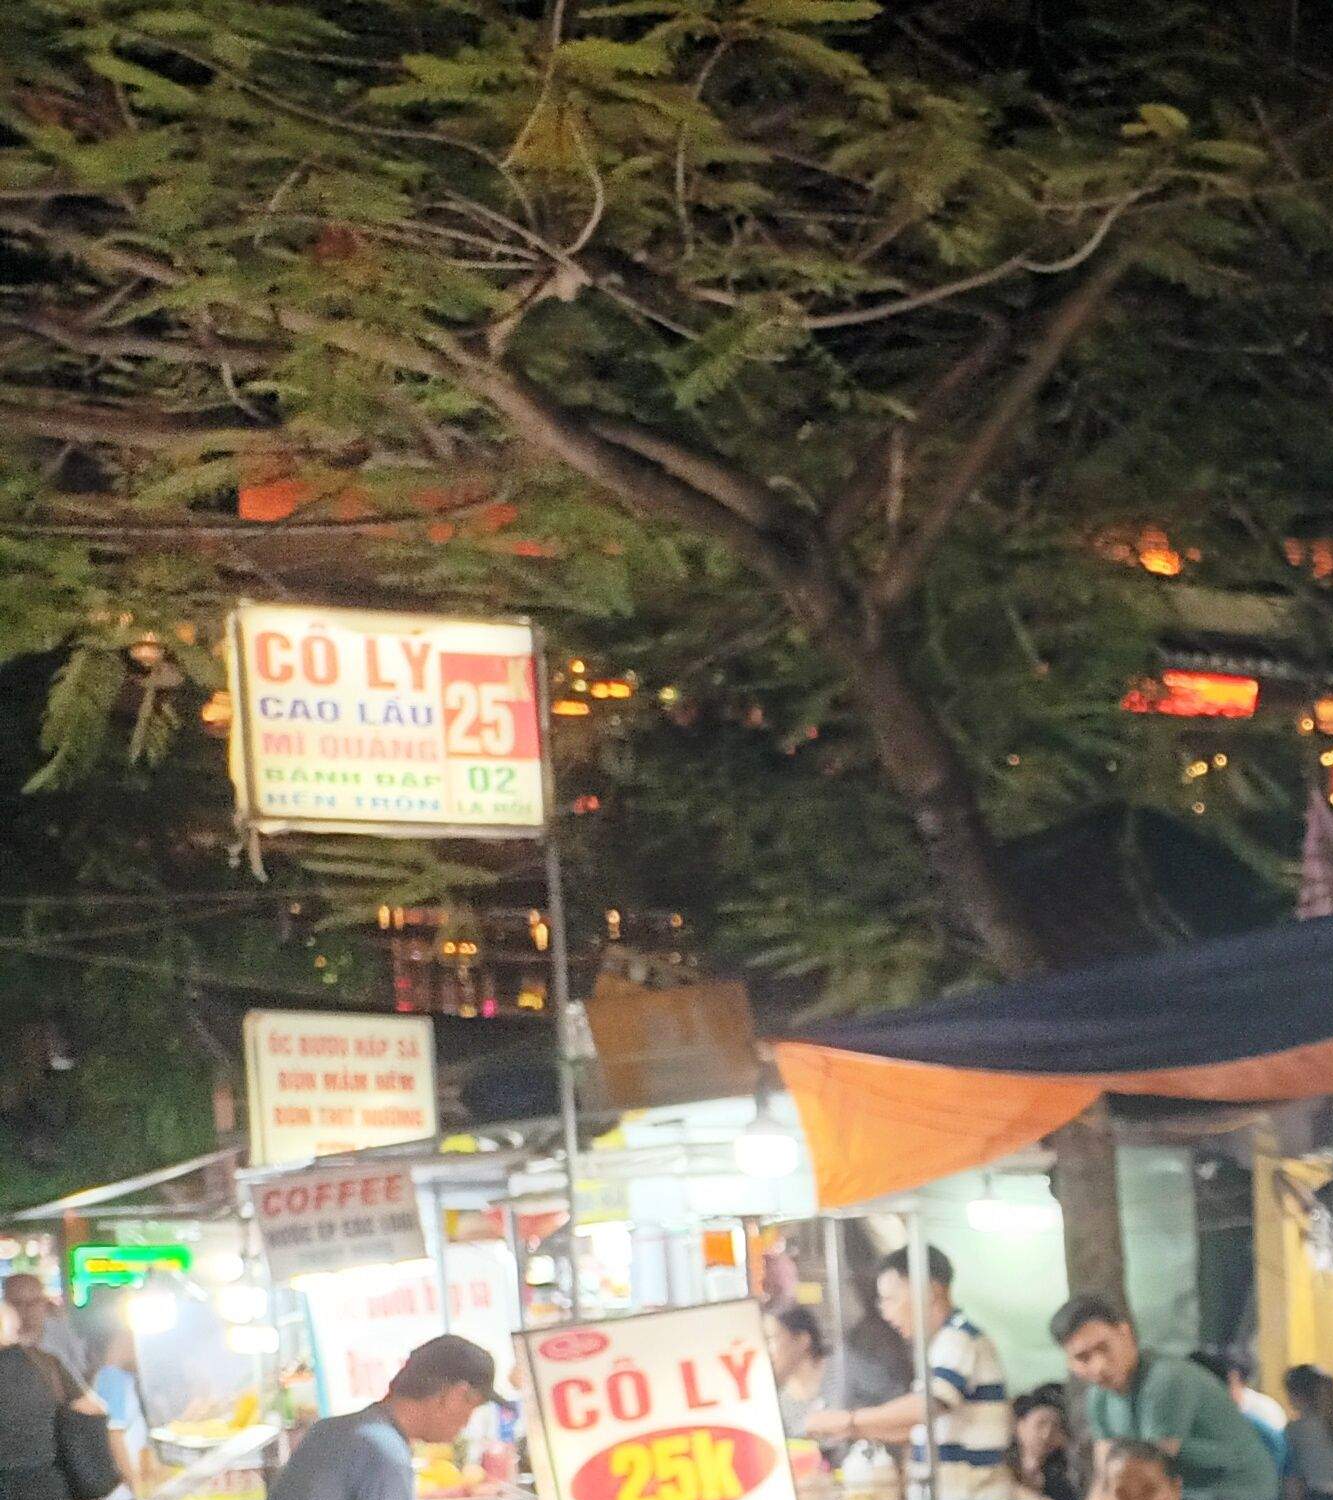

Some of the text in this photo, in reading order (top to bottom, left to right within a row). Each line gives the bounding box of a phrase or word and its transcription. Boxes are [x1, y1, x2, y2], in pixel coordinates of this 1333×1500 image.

[254, 622, 340, 686] CÔ
[258, 696, 341, 723] CAO
[468, 765, 517, 796] 02
[262, 1173, 403, 1217] COFFEE
[550, 1356, 653, 1432] CÔ
[679, 1338, 758, 1411] LÝ
